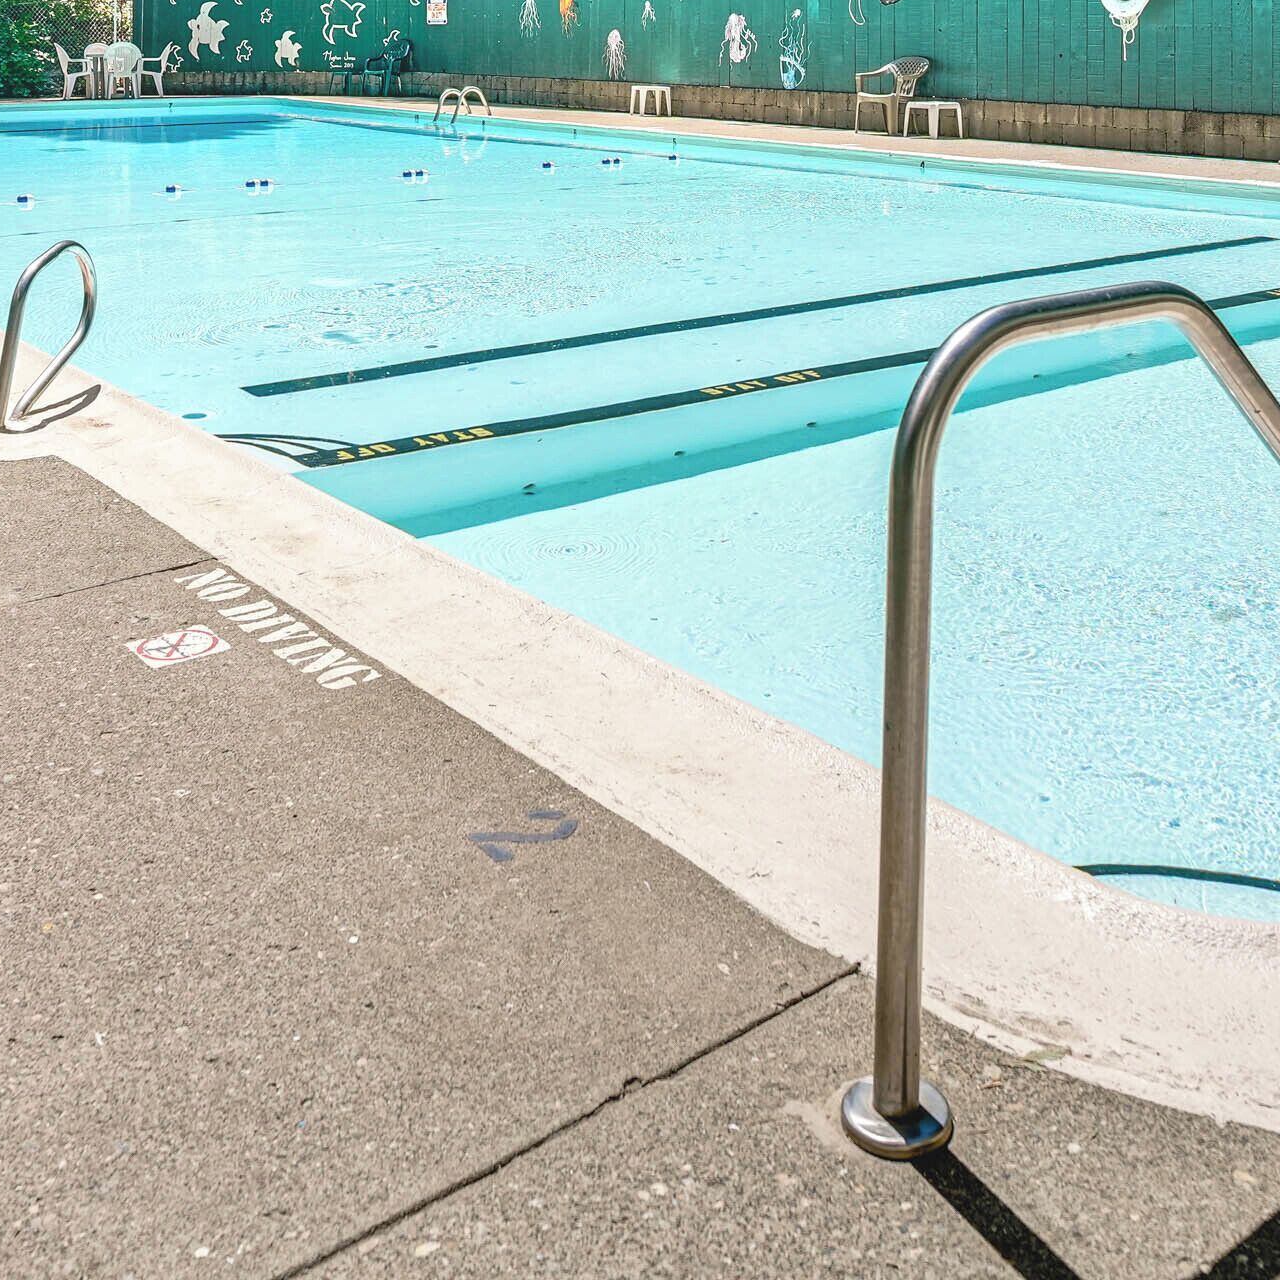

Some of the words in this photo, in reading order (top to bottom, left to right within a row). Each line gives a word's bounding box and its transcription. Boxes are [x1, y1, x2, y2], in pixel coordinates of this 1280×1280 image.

[701, 378, 769, 398] STAY
[775, 370, 822, 384] OFF
[413, 427, 495, 449] STAY
[336, 443, 397, 462] OFF
[174, 568, 251, 602] NO
[218, 598, 382, 690] DIVING
